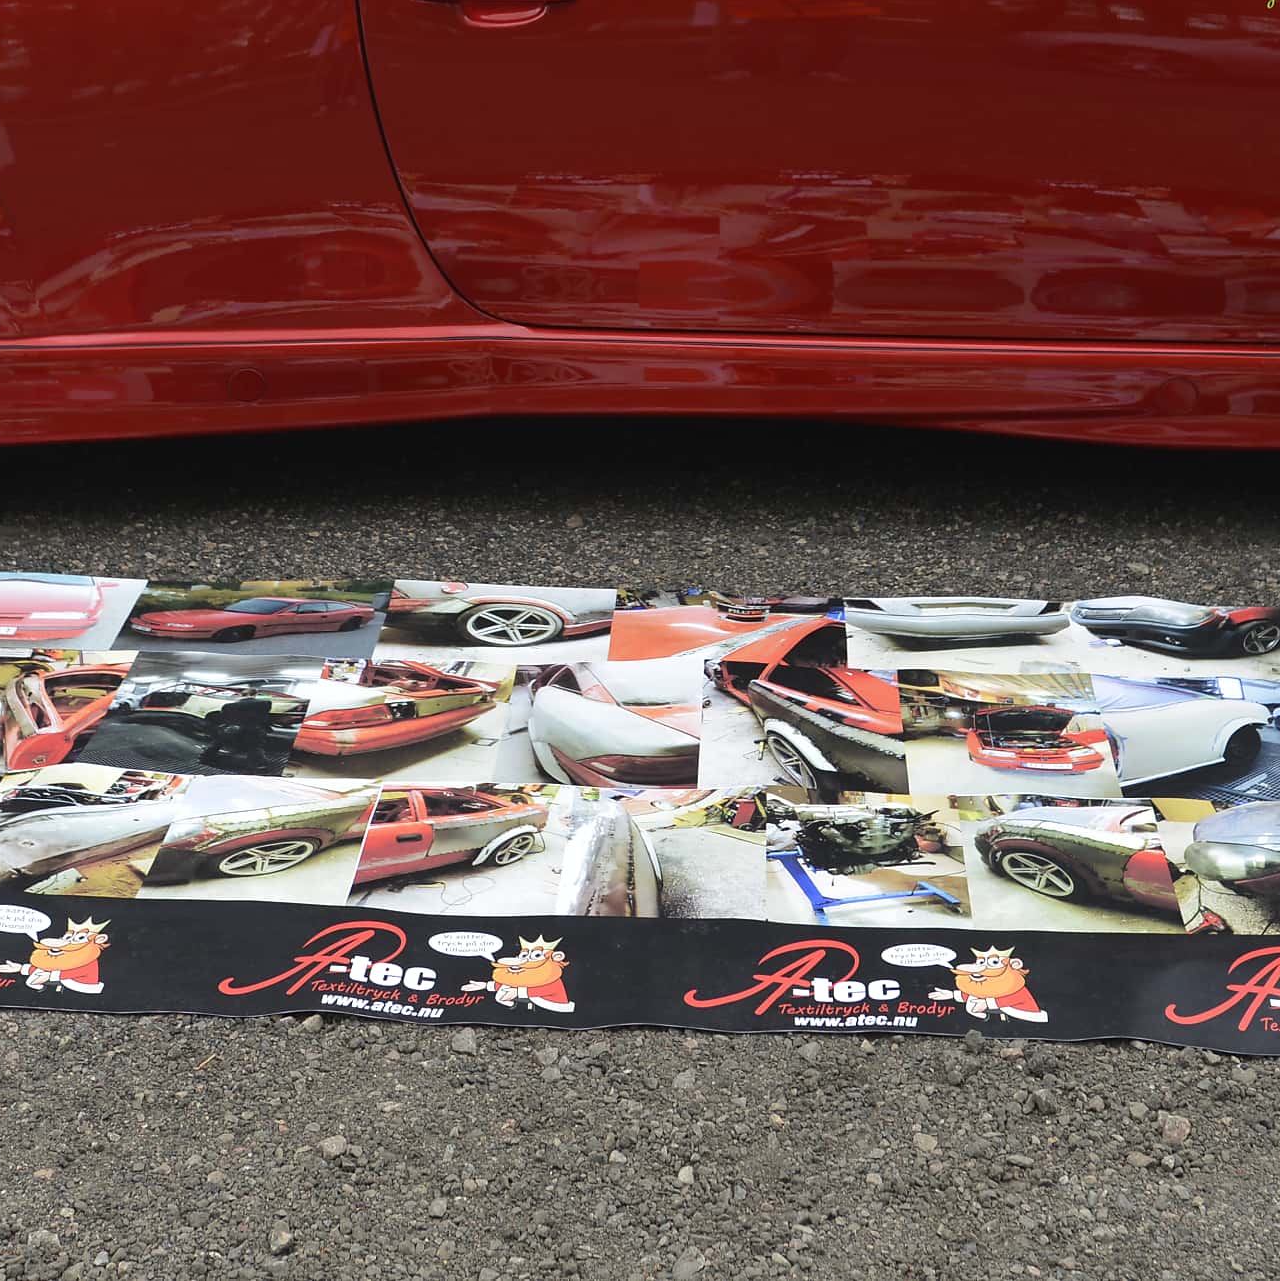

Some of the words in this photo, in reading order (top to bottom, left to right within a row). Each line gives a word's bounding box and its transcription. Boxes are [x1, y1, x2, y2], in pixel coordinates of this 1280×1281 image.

[310, 979, 401, 1002] Textiltryck
[408, 992, 419, 1004] &
[426, 991, 486, 1008] Brodyr
[321, 991, 445, 1019] www.atec.nu
[777, 1002, 871, 1017] Textiltryck
[878, 1003, 889, 1013] &
[897, 1001, 956, 1017] Brodyr
[794, 1014, 918, 1029] www.atec.nu
